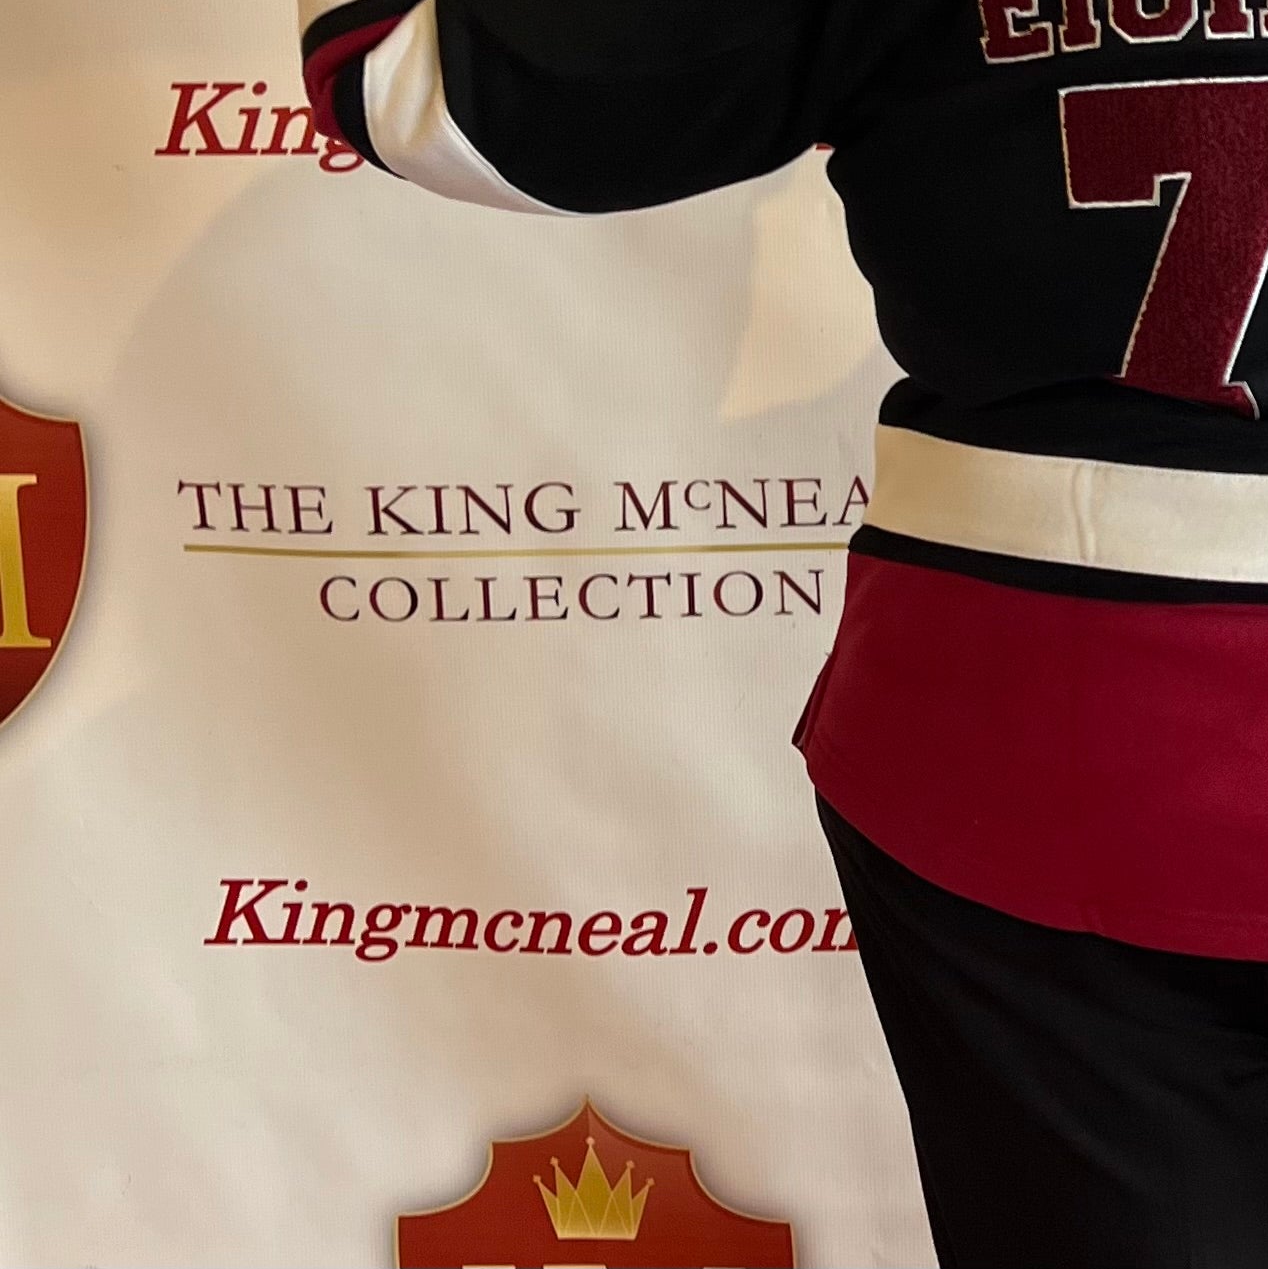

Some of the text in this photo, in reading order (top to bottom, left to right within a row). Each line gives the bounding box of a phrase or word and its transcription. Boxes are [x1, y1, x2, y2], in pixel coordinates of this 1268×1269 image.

[177, 479, 334, 535] THE
[367, 482, 582, 536] KING
[319, 569, 824, 624] COLLECTION
